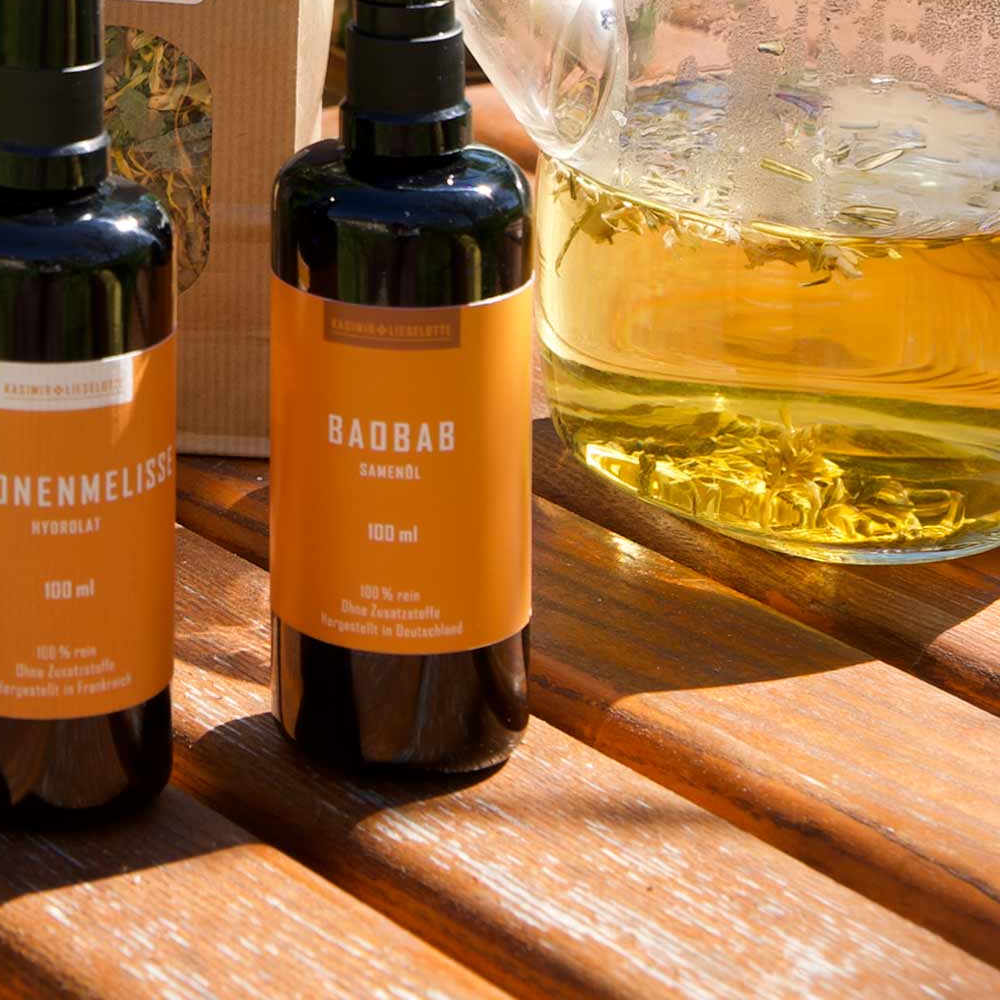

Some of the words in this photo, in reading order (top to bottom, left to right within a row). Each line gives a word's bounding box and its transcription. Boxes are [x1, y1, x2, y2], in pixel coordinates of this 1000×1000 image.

[327, 412, 456, 453] BAOBAB
[359, 461, 422, 480] SAMENÖL
[31, 517, 102, 536] HYDROLAT
[367, 522, 395, 542] 100
[398, 524, 418, 544] ml
[44, 580, 72, 600] 100
[75, 578, 95, 598] ml
[359, 584, 380, 600] 100
[382, 585, 393, 601] %
[396, 589, 421, 603] rein
[341, 599, 368, 617] Ohne
[371, 604, 441, 620] Zusatzstoffe
[320, 610, 378, 636] Hergestellt
[381, 624, 393, 637] in
[395, 618, 464, 638] Deutschland
[36, 644, 57, 660] 100
